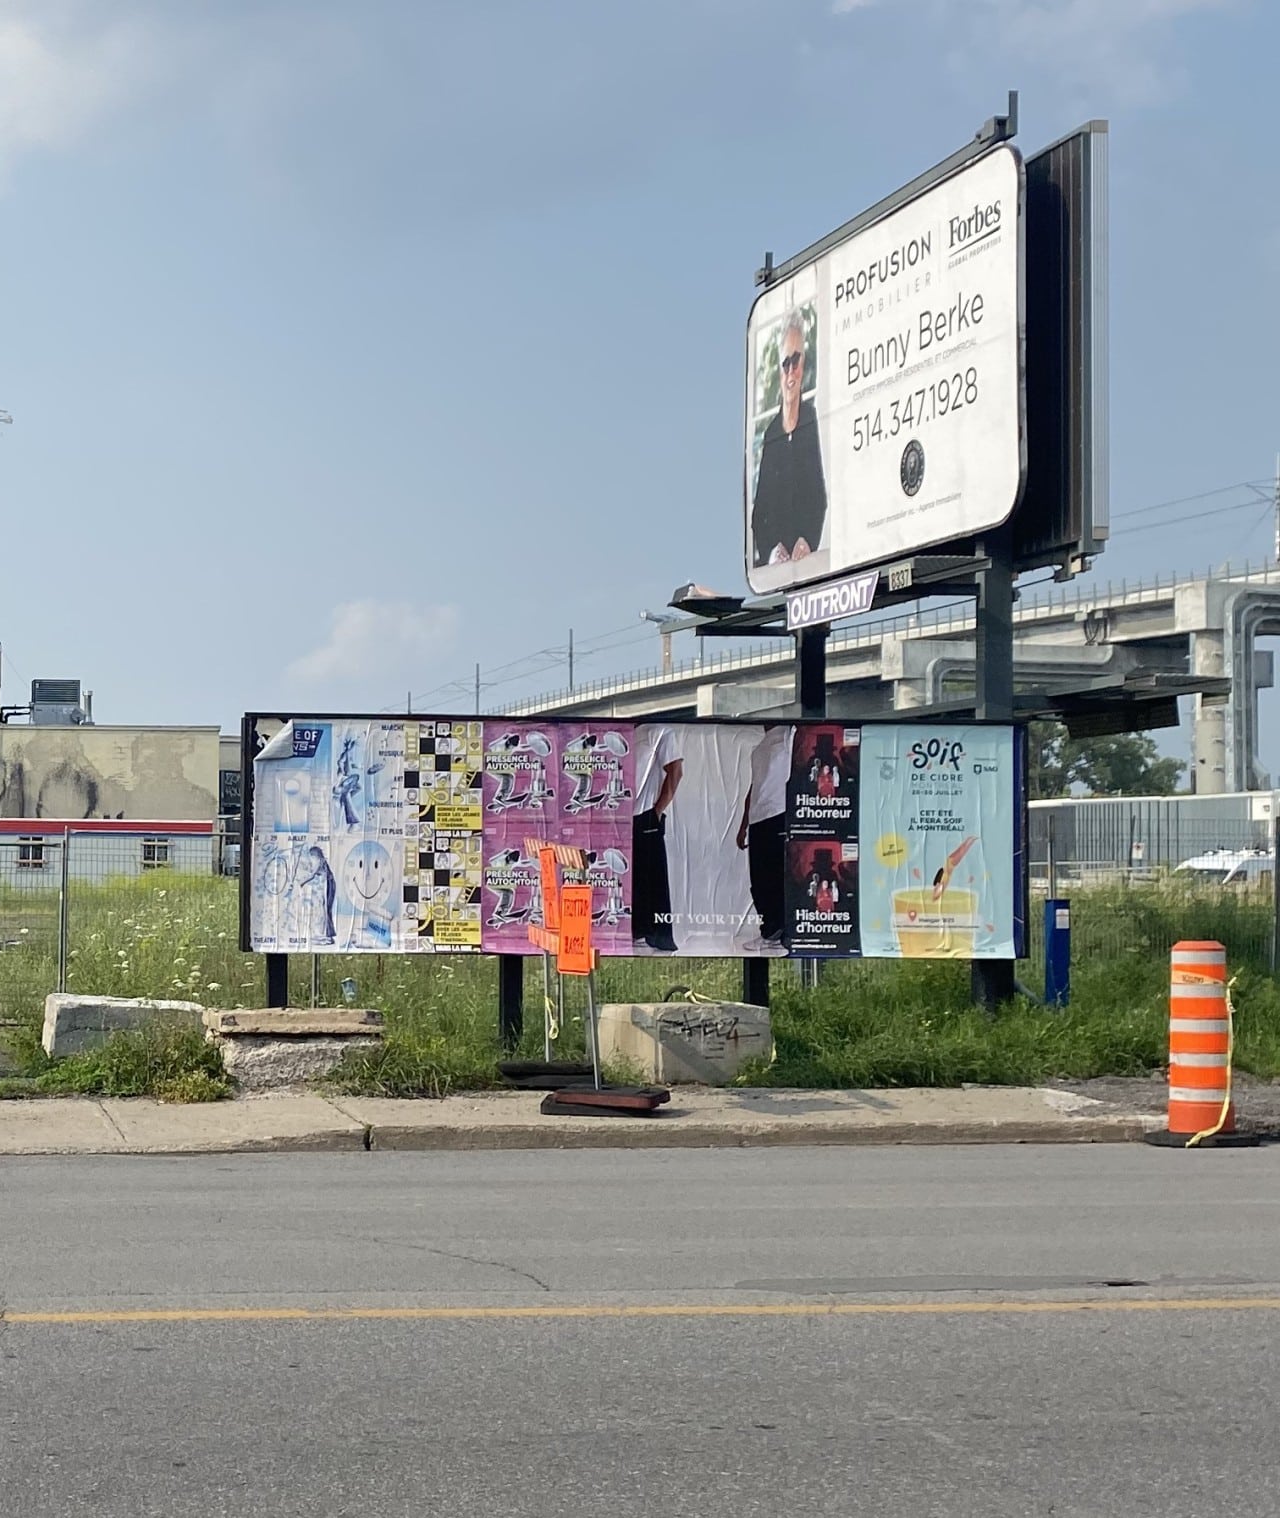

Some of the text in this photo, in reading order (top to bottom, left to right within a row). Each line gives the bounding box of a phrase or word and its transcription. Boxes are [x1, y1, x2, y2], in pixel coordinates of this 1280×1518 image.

[948, 200, 1001, 248] Forbes
[835, 230, 931, 308] PROFUSION
[835, 271, 931, 336] IMMOBILIER
[848, 291, 984, 385] Bunny Berke
[853, 366, 978, 451] 514.347.1928
[891, 569, 909, 590] 8337
[791, 578, 872, 624] OUTFRONT
[304, 730, 318, 742] OF
[796, 794, 850, 806] Histoires
[796, 806, 852, 818] d'horreur
[654, 912, 765, 925] NOT YOUR TYPE
[795, 909, 850, 921] Histoires
[796, 921, 852, 933] d'horreur
